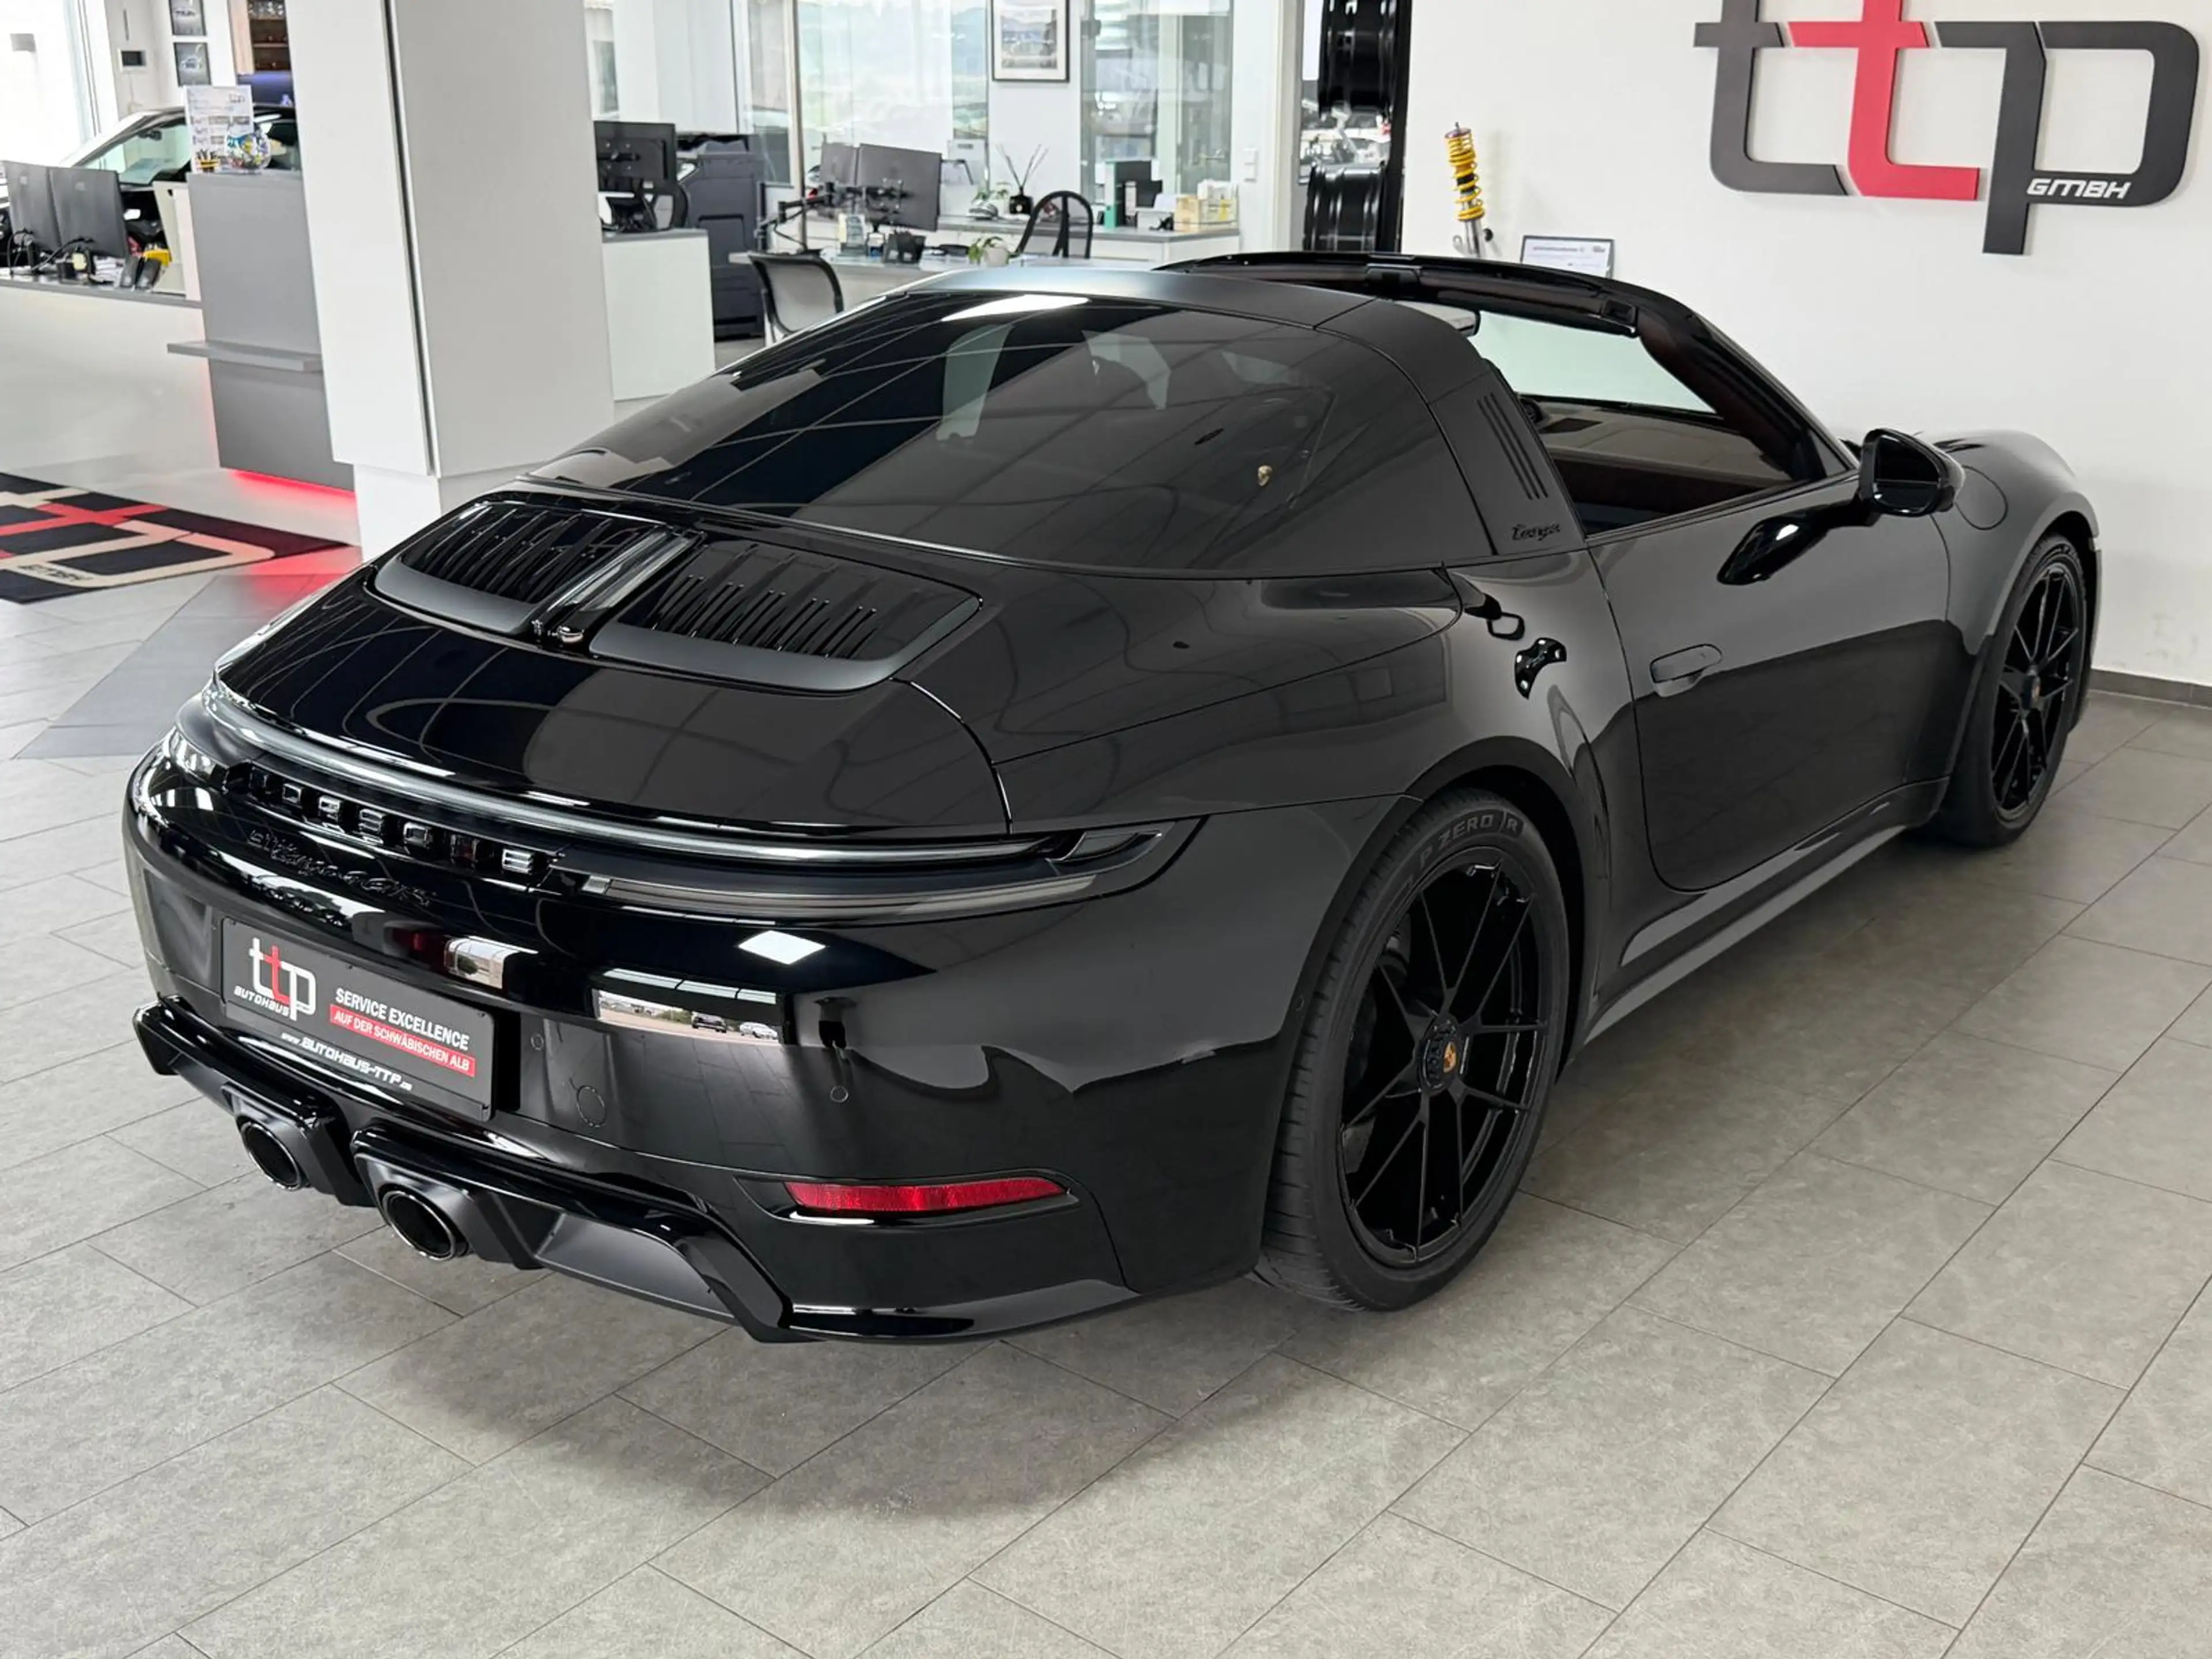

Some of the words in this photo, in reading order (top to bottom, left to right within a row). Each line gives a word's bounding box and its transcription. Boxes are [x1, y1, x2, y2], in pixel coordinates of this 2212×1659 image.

[1694, 0, 2200, 255] ttp
[249, 767, 537, 877] PORSCHE
[1437, 813, 1495, 850] ZERO
[233, 985, 290, 1017] AUTOHAUS
[249, 937, 316, 1021] ttp
[334, 1010, 353, 1025] AUF
[354, 1017, 373, 1035] DER
[374, 1024, 449, 1065] SCHWÄBISCHEN
[449, 1054, 471, 1072] ALB
[335, 987, 388, 1020] SERVICE
[388, 1007, 470, 1051] EXCELLENCE
